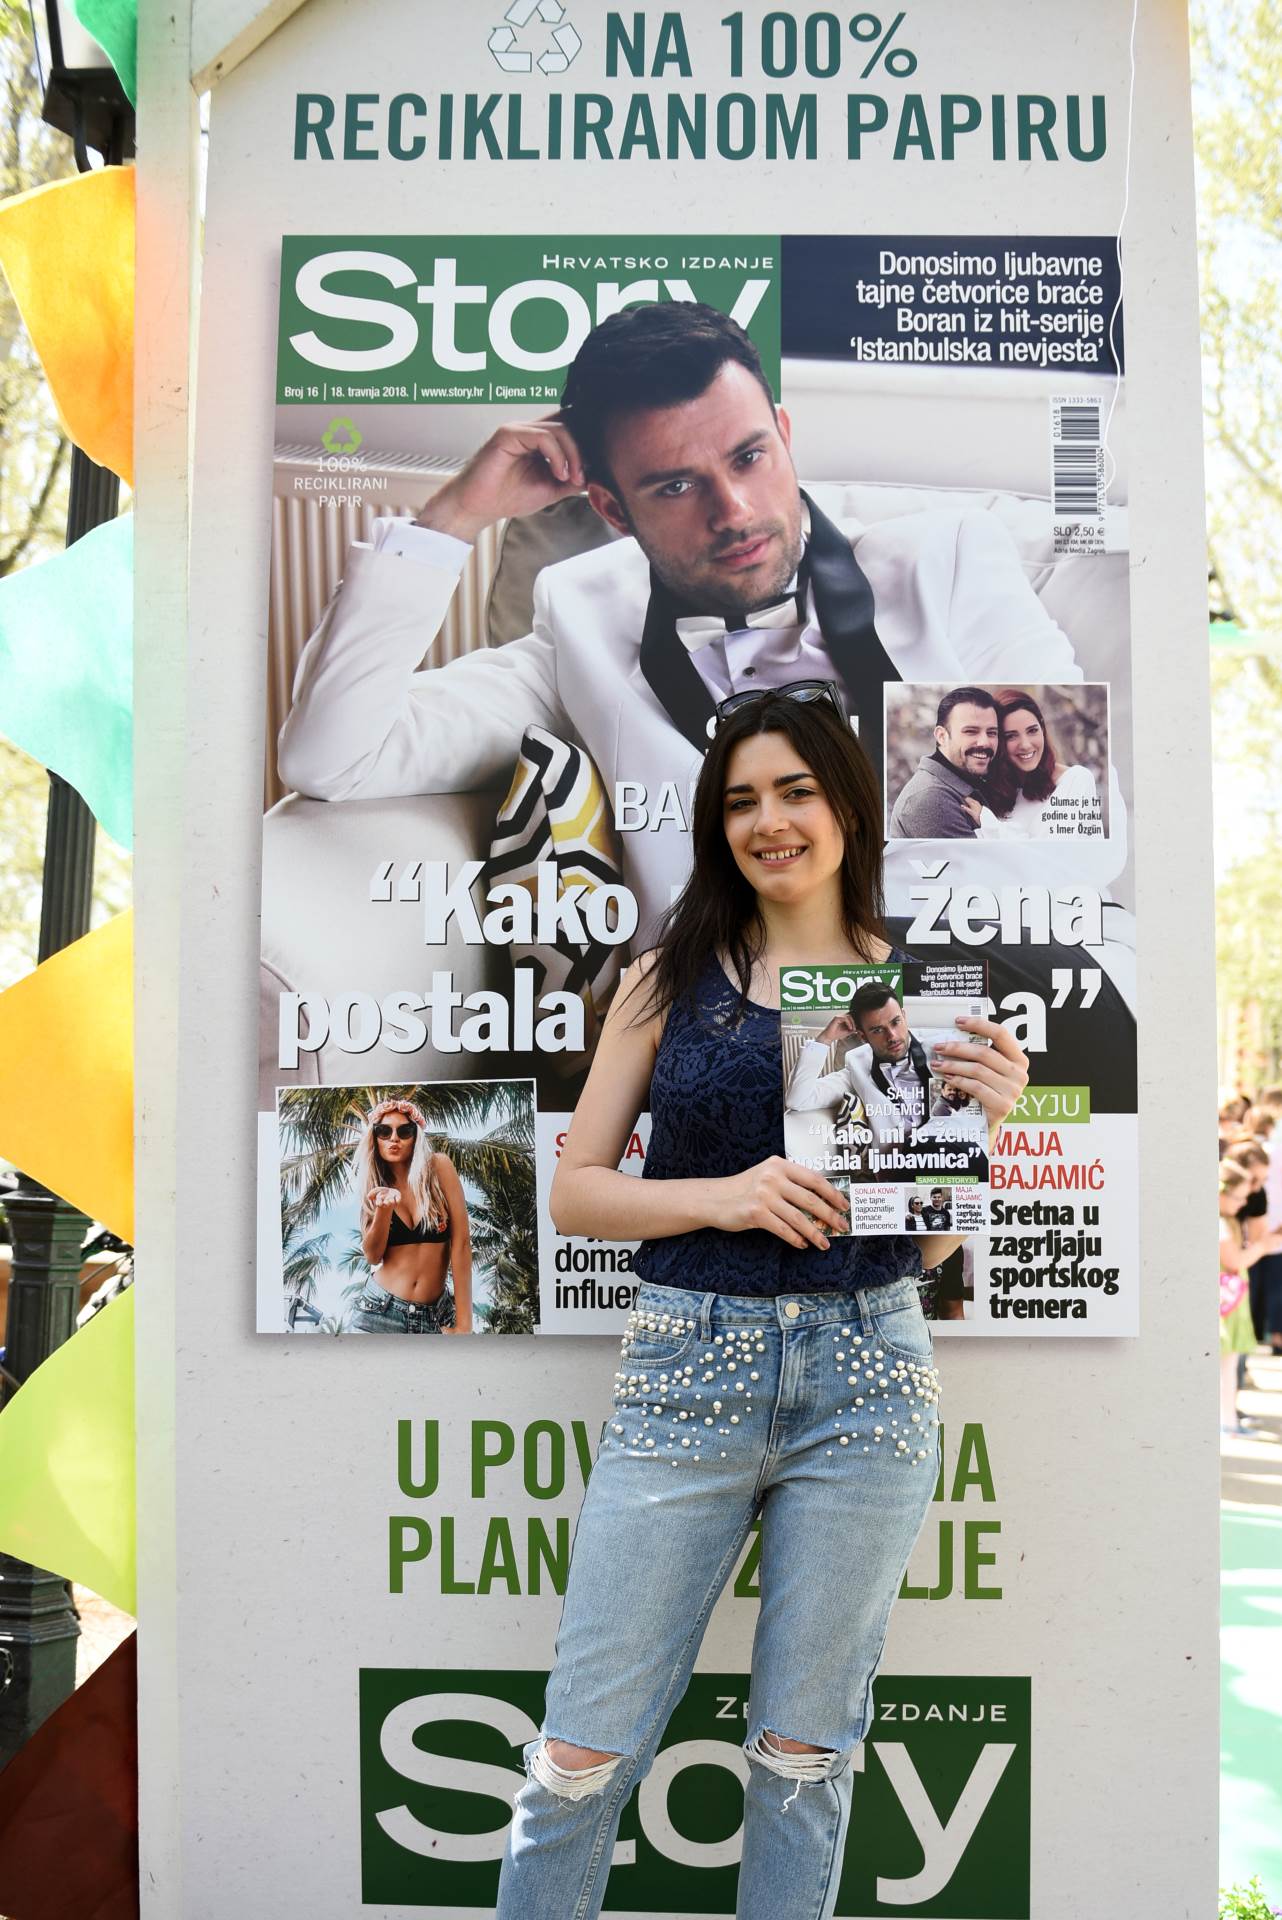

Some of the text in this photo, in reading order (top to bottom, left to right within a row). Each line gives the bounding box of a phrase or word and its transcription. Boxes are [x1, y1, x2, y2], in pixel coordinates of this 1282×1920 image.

[606, 11, 917, 79] NA 100%
[293, 92, 1107, 162] RECIKLIRANOM PAPIRU
[542, 254, 774, 269] HRVATSKO IZDANJE
[879, 251, 1103, 281] Donosimo ljubavne
[856, 278, 1103, 309] tajne četvorice braće
[897, 308, 1104, 338] Boran iz hit-serije
[850, 336, 1104, 367] ‘Istanbulska nevjesta’
[284, 386, 558, 400] Broj 16 18. travnja 2018. www.story.hr Cijena 12 kn
[316, 457, 368, 472] 100%
[294, 477, 388, 490] RECIKLIRANI
[318, 495, 362, 508] PAPIR
[1053, 526, 1072, 537] SLO
[1074, 526, 1095, 537] 2,50
[1050, 796, 1079, 807] Glumac
[1081, 796, 1089, 808] je
[1041, 810, 1102, 822] godine u braku
[905, 859, 1104, 947] žena
[926, 965, 957, 974] Donosimo
[278, 968, 586, 1070] postala
[886, 1086, 925, 1100] SALIH
[1013, 1093, 1080, 1118] RYJU
[865, 1103, 925, 1117] BADEMCI
[879, 1121, 905, 1144] mi
[908, 1121, 929, 1147] je
[934, 1121, 981, 1143] žena
[991, 1131, 1063, 1157] MAJA
[794, 1150, 862, 1171] ostala
[990, 1159, 1105, 1191] BAJAMIĆ
[854, 1196, 868, 1204] Sve
[990, 1199, 1100, 1226] Sretna u
[555, 1242, 635, 1272] doma
[989, 1229, 1102, 1264] zagrljaju
[989, 1261, 1120, 1295] sportskog
[989, 1293, 1088, 1319] trenera
[397, 1419, 440, 1499] U
[389, 1515, 569, 1596] PLAN
[375, 1692, 1017, 1905] Soy
